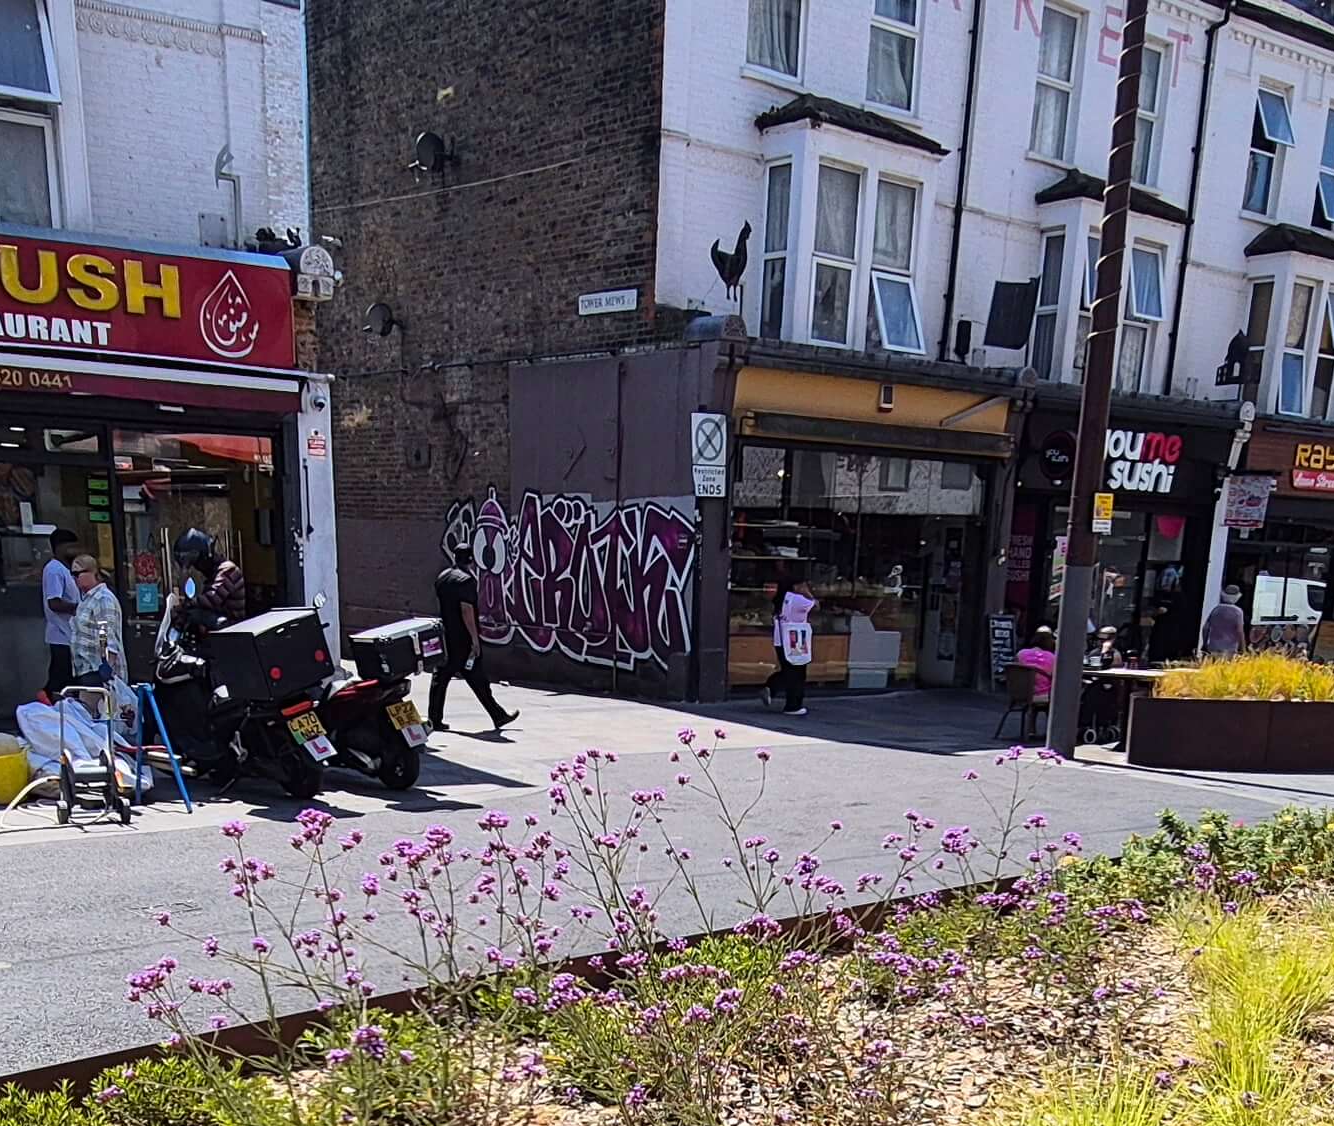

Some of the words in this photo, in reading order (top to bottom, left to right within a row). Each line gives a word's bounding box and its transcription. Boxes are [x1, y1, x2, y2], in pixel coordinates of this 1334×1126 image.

[29, 371, 73, 389] 0441
[702, 474, 716, 482] Zone
[1107, 458, 1176, 494] sushi
[698, 484, 722, 495] ENDS
[312, 741, 328, 754] L
